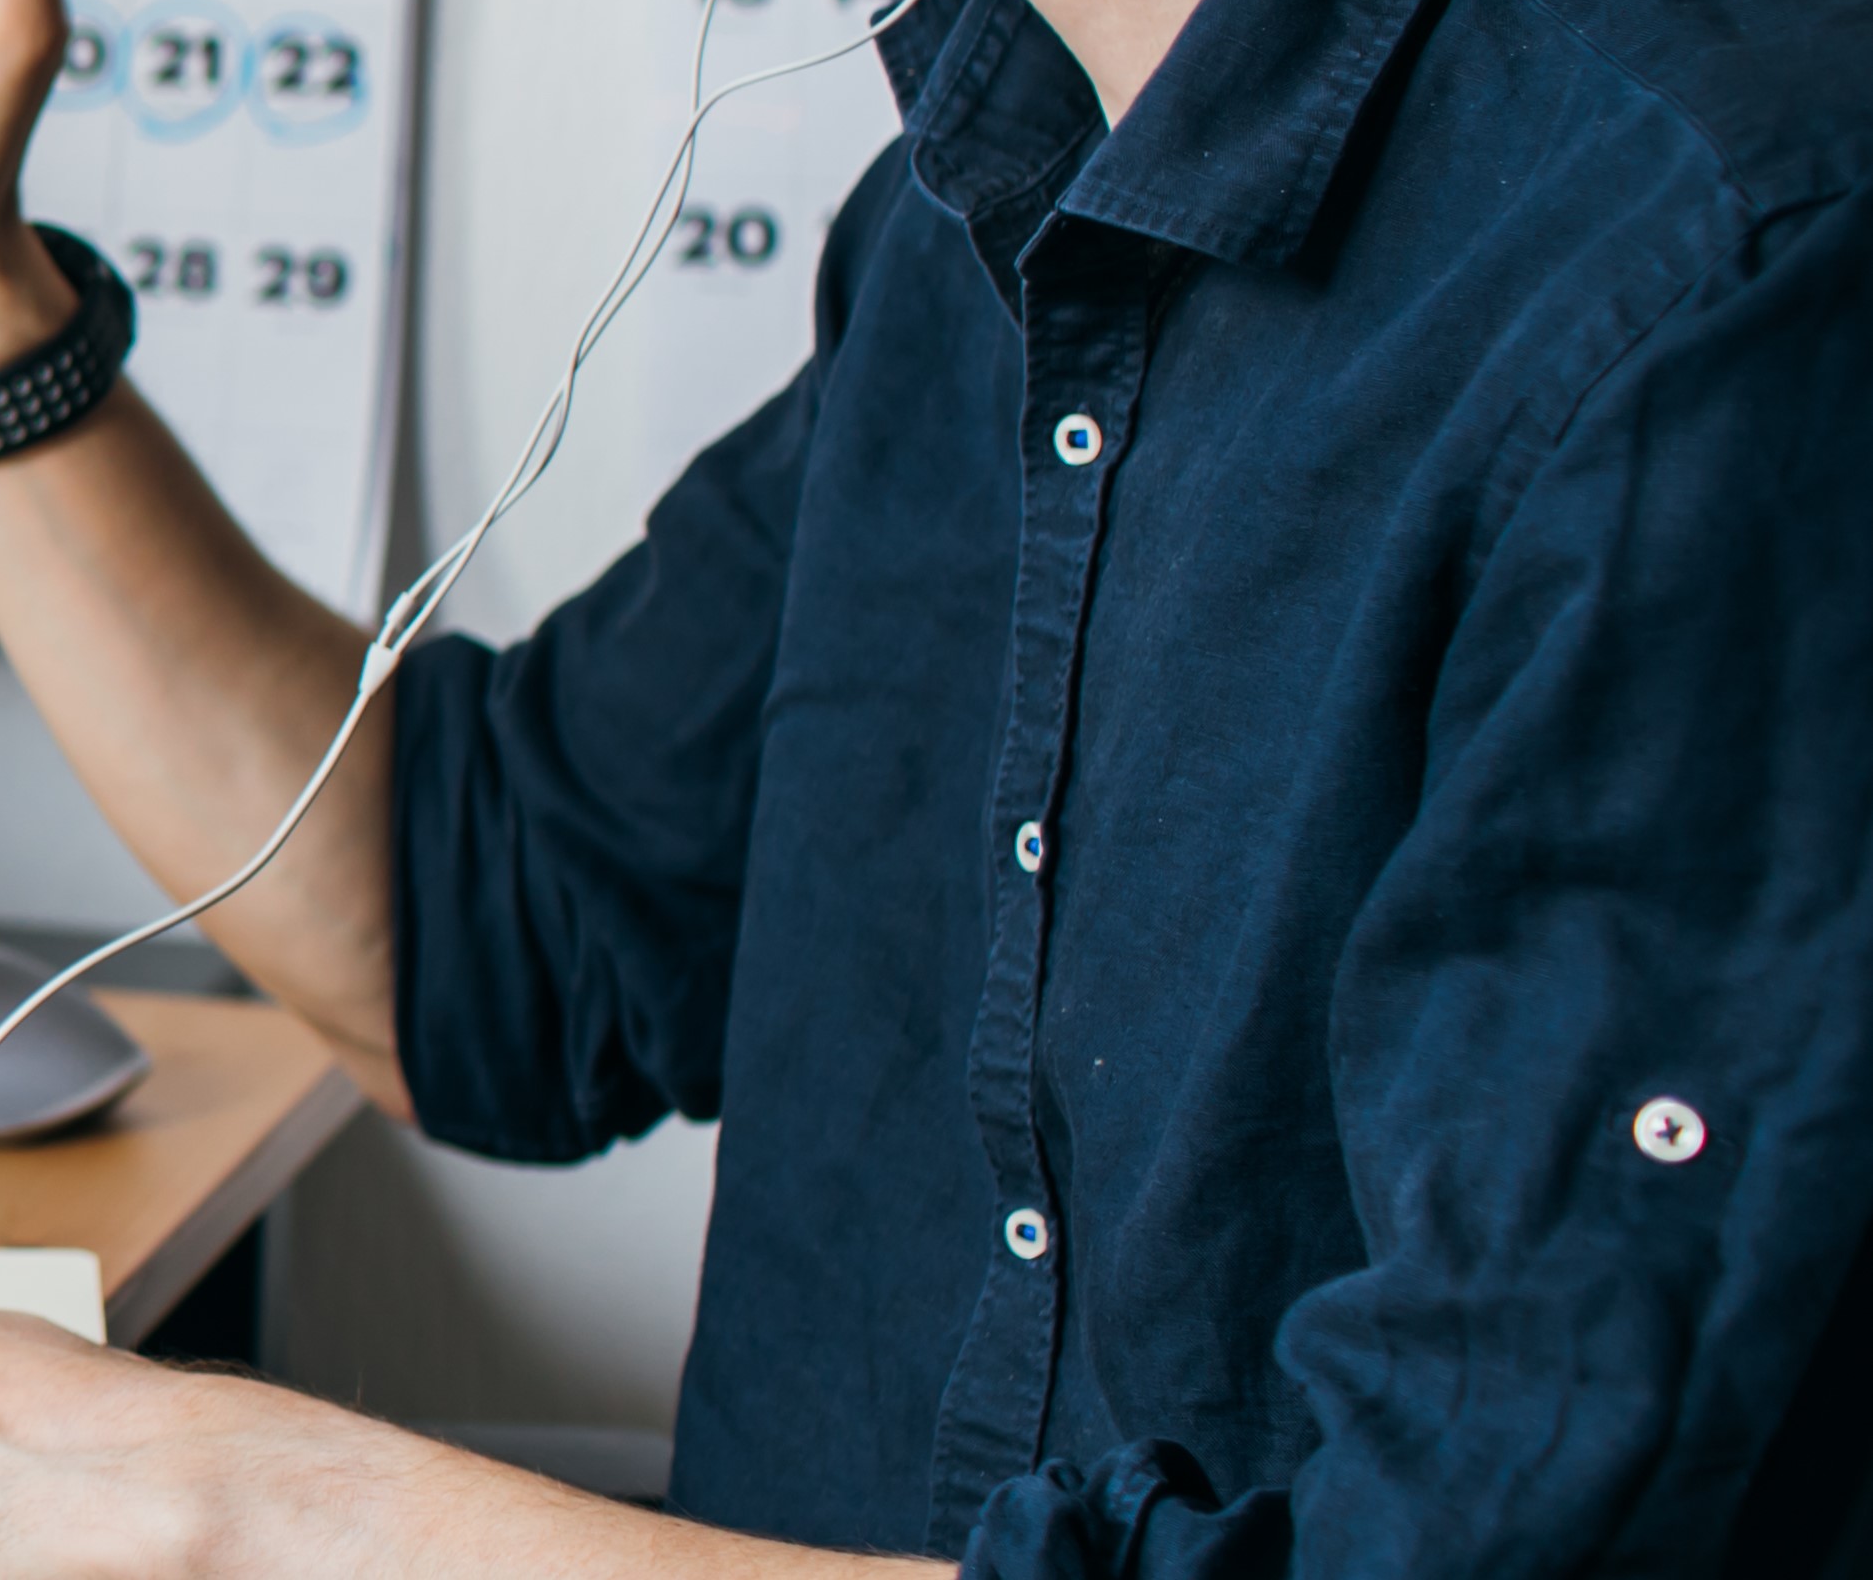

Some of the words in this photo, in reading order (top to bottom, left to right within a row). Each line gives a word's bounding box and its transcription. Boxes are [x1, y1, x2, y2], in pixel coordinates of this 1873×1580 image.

[65, 26, 109, 86] 0
[150, 30, 226, 89] 21
[267, 31, 365, 100] 22
[675, 204, 783, 267] 20
[131, 238, 220, 298] 28
[256, 246, 353, 307] 29
